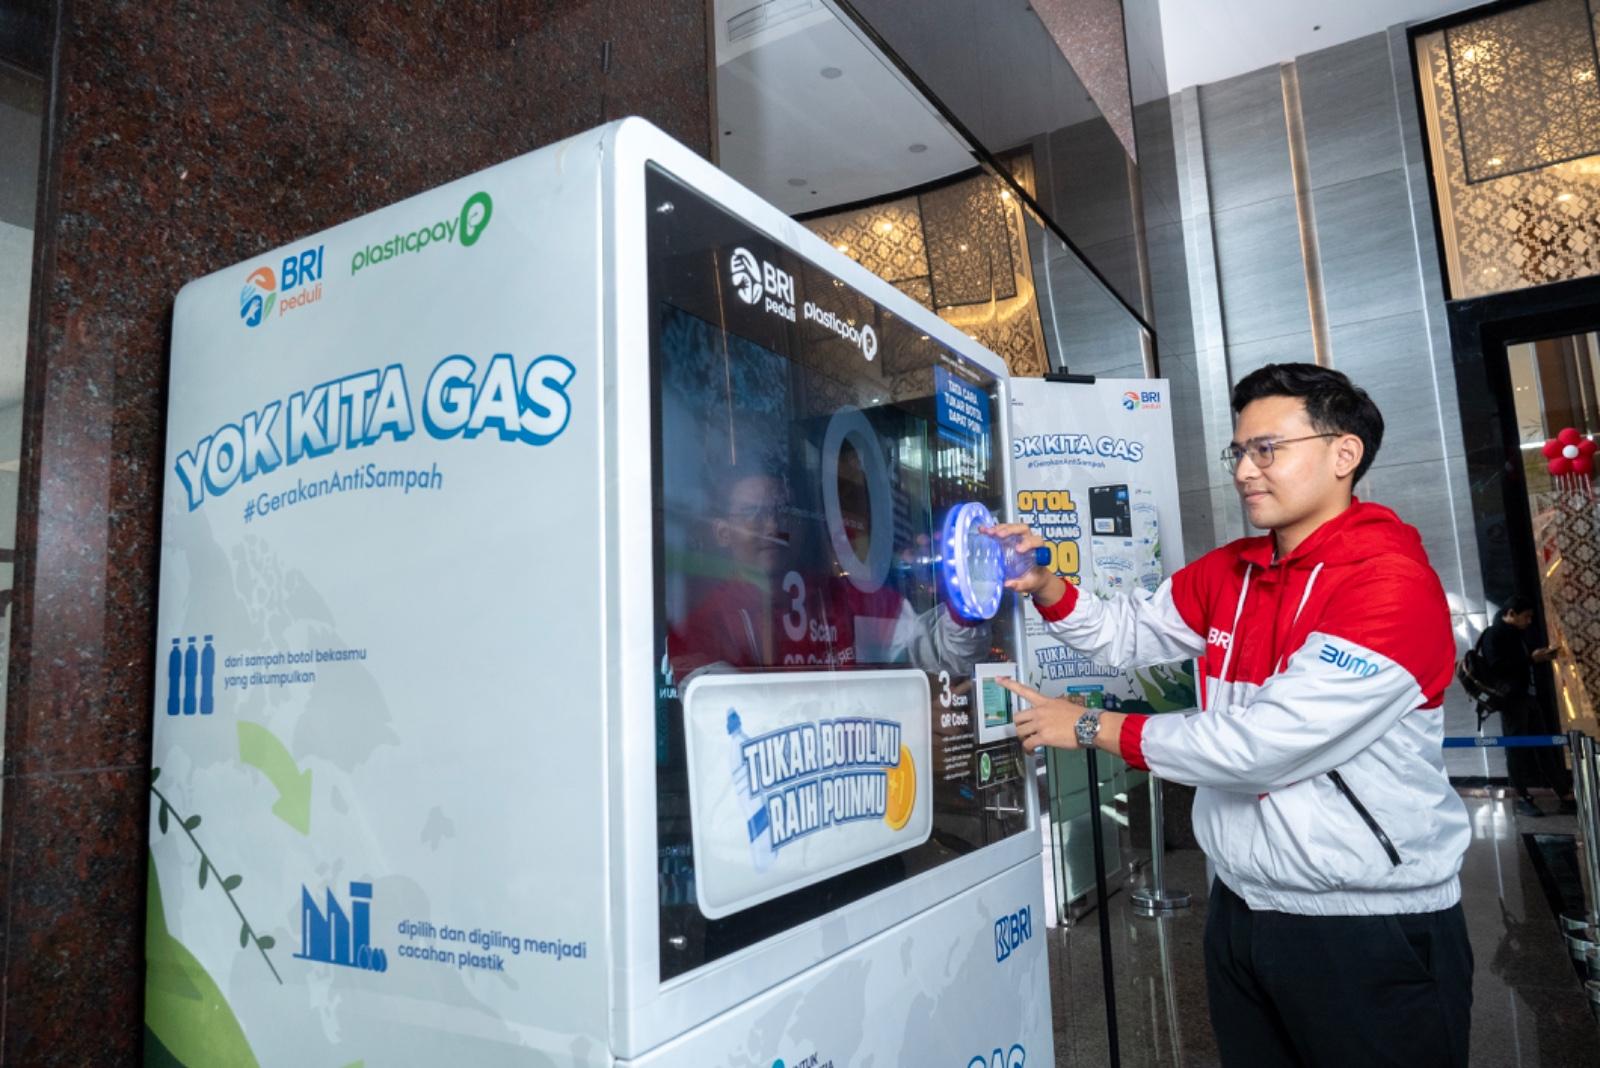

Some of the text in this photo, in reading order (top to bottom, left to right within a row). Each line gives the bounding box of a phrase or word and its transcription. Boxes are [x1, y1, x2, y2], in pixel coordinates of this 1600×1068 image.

[351, 217, 459, 276] plasticpay
[281, 245, 324, 291] BRI
[763, 260, 795, 306] BRI
[279, 283, 322, 316] peduli
[764, 297, 796, 323] peduli
[804, 302, 863, 348] plasticpay
[1141, 391, 1160, 403] BRI
[175, 354, 576, 511] YOK KITA GAS
[1014, 433, 1144, 462] OK KITA GAS
[242, 462, 443, 523] #GerakanAntiSampah
[1017, 490, 1076, 512] OTOL
[1045, 525, 1081, 540] UANG
[781, 568, 808, 642] 3
[808, 618, 838, 642] Scan
[1208, 625, 1231, 649] BR
[224, 647, 367, 669] dari sampah botol bekasmu
[224, 670, 316, 690] yang dikumpulkan
[938, 670, 951, 708] 3
[952, 693, 968, 706] Scan
[941, 711, 969, 729] QR Code
[741, 717, 901, 795] TUKAR BOTOLMU
[768, 769, 888, 851] RAIH POINMU
[398, 919, 587, 961] dipilih dan digiling menjadi
[1009, 904, 1032, 950] BRI
[398, 943, 504, 971] cacahan plastik
